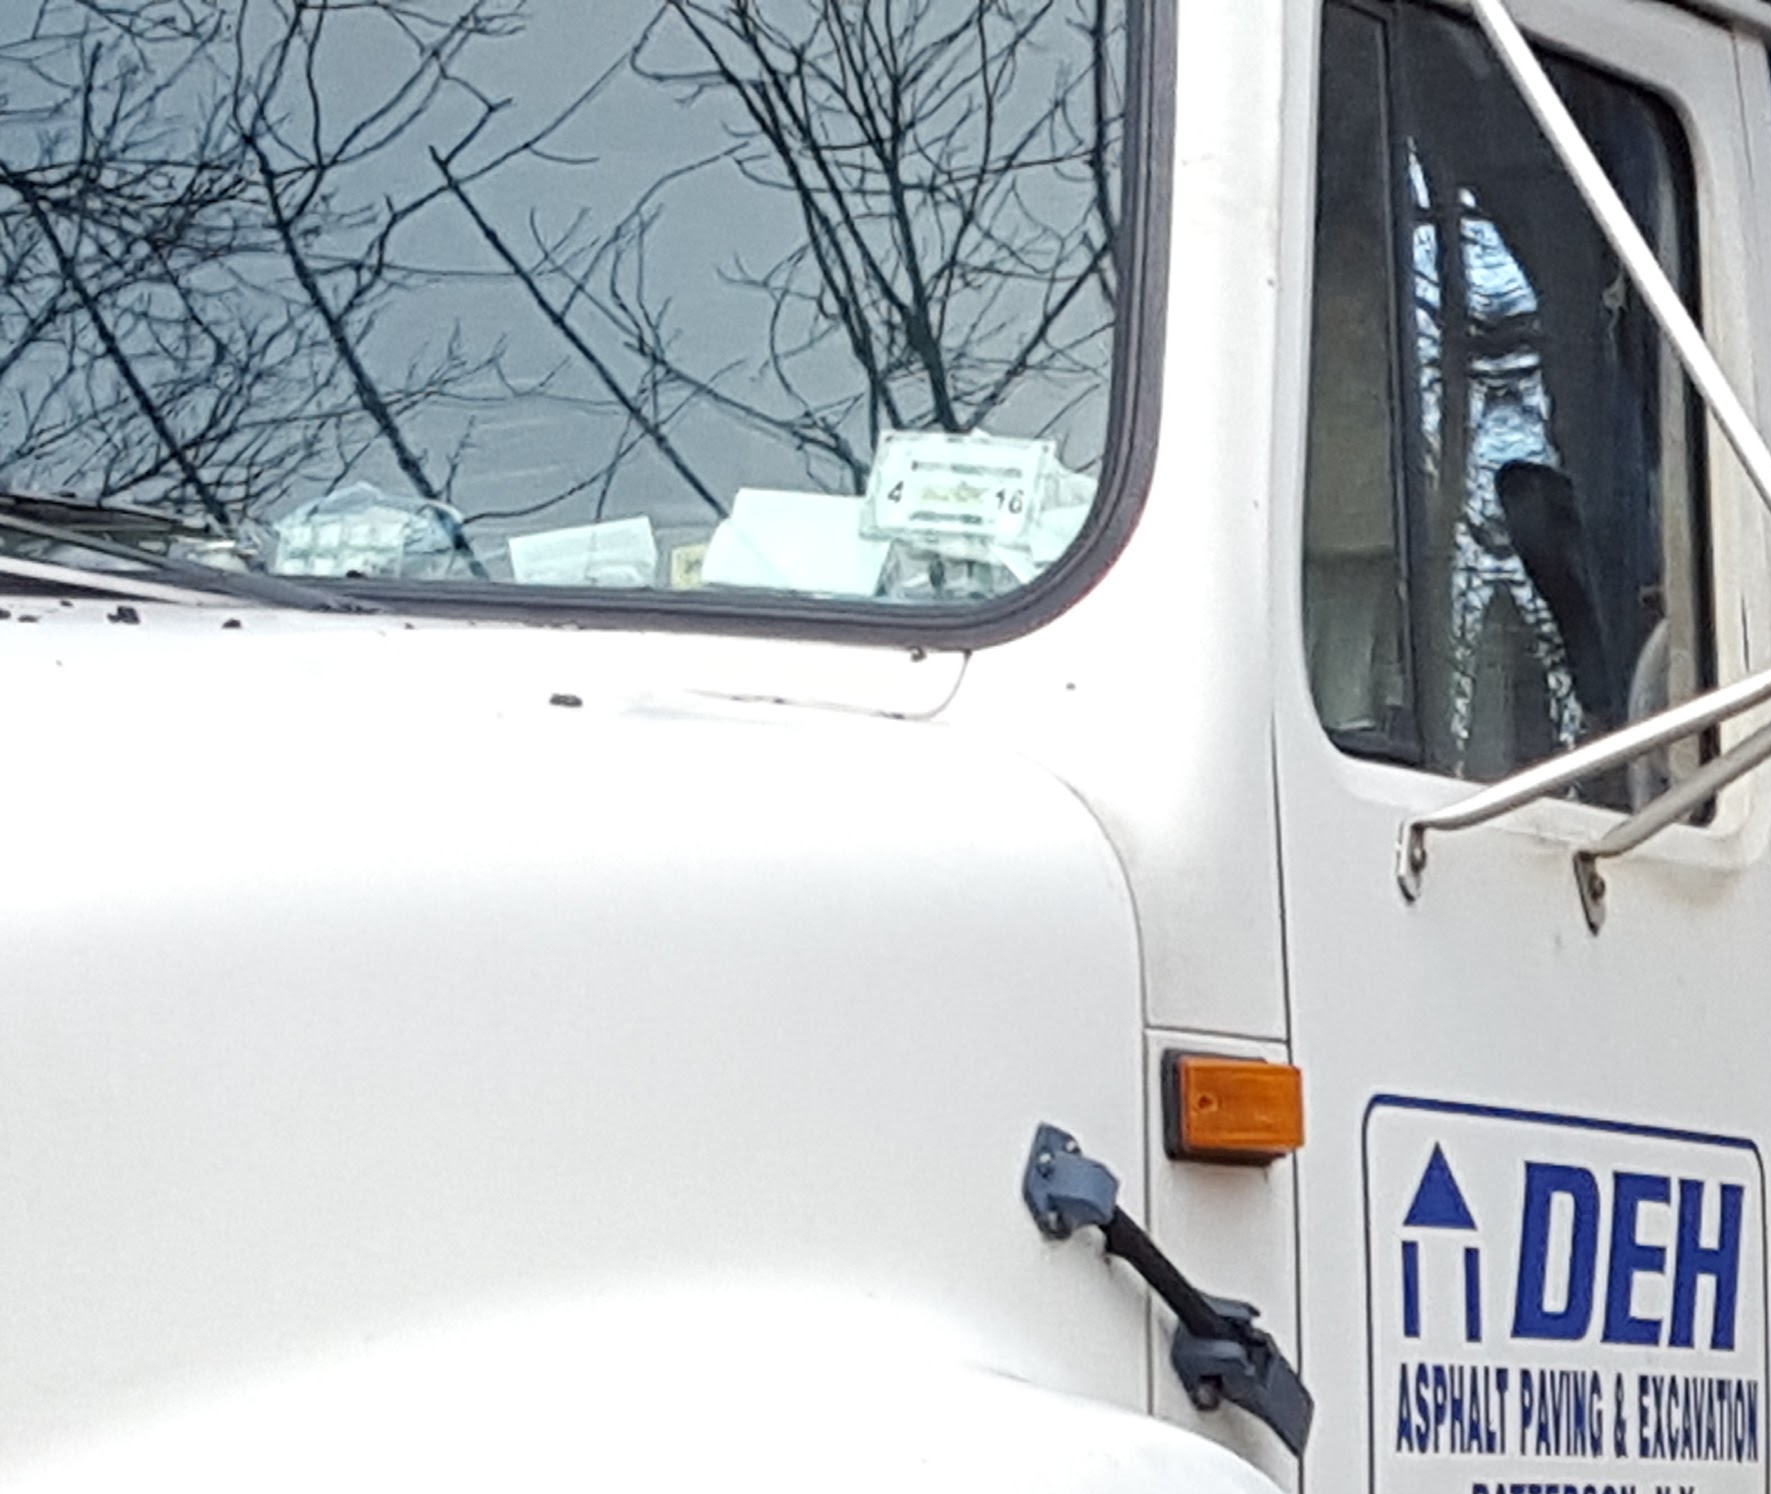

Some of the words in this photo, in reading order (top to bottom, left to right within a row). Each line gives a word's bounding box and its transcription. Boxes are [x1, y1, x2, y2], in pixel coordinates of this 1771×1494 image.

[887, 480, 904, 503] 4
[995, 488, 1025, 514] 16
[1511, 1160, 1745, 1352] DEH
[1396, 1362, 1510, 1456] ASPHALT
[1520, 1369, 1602, 1460] PAVING
[1615, 1372, 1628, 1458] &
[1639, 1373, 1758, 1462] EXCAVATION
